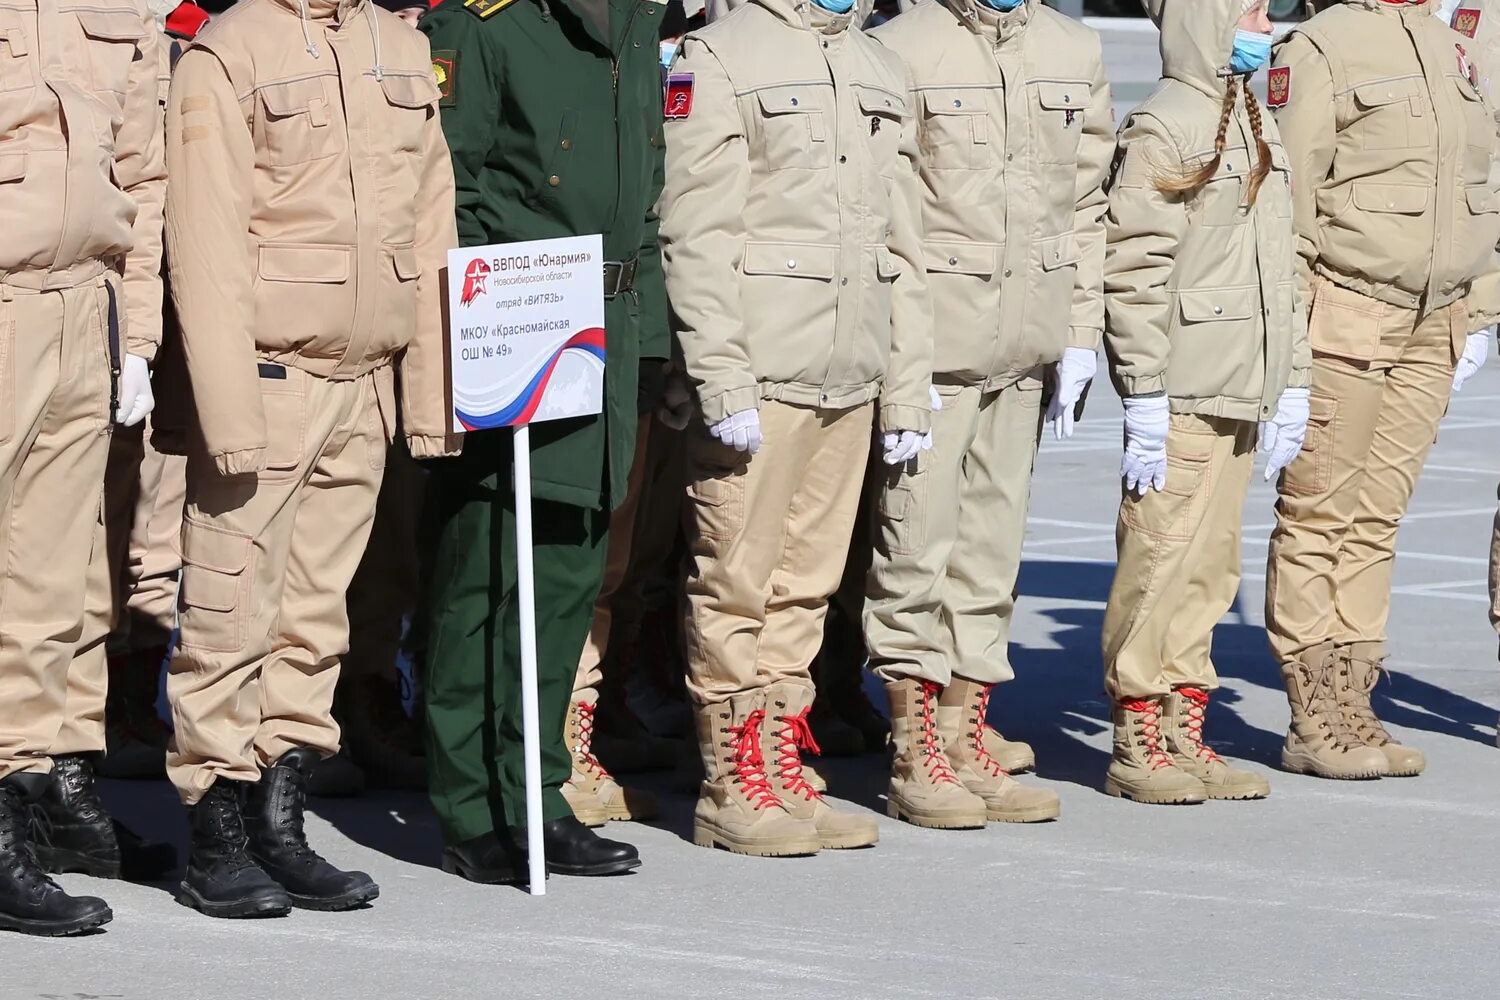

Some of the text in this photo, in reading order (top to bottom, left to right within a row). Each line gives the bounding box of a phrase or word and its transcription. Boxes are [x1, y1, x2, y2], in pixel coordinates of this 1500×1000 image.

[493, 251, 592, 272] ВВПОД «Юнармия»
[493, 270, 573, 287] Новосибирской области
[495, 291, 564, 310] отряд «ВИТЯЗЬ»
[460, 318, 570, 341] МКОУ «Красномайская
[461, 343, 513, 361] ОШ № 49»
